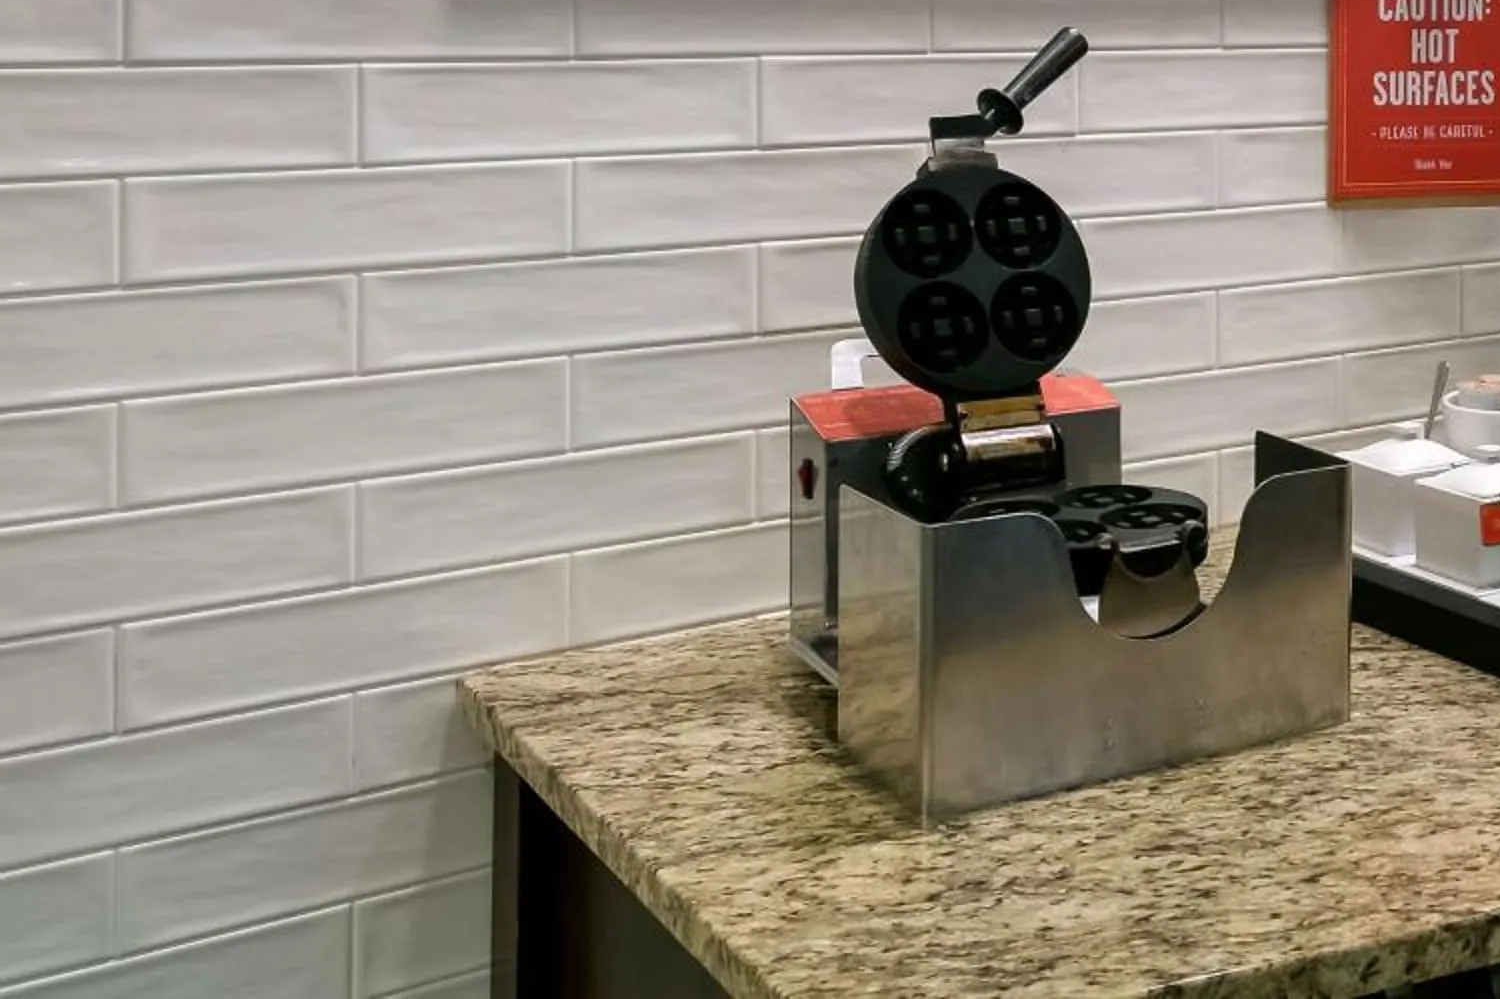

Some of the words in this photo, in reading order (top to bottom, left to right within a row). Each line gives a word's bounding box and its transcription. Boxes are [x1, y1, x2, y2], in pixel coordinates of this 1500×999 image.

[1410, 28, 1460, 65] HOT
[1372, 69, 1496, 107] SURFACES
[1379, 125, 1419, 141] PLEASE
[1439, 123, 1486, 138] CAREFUL
